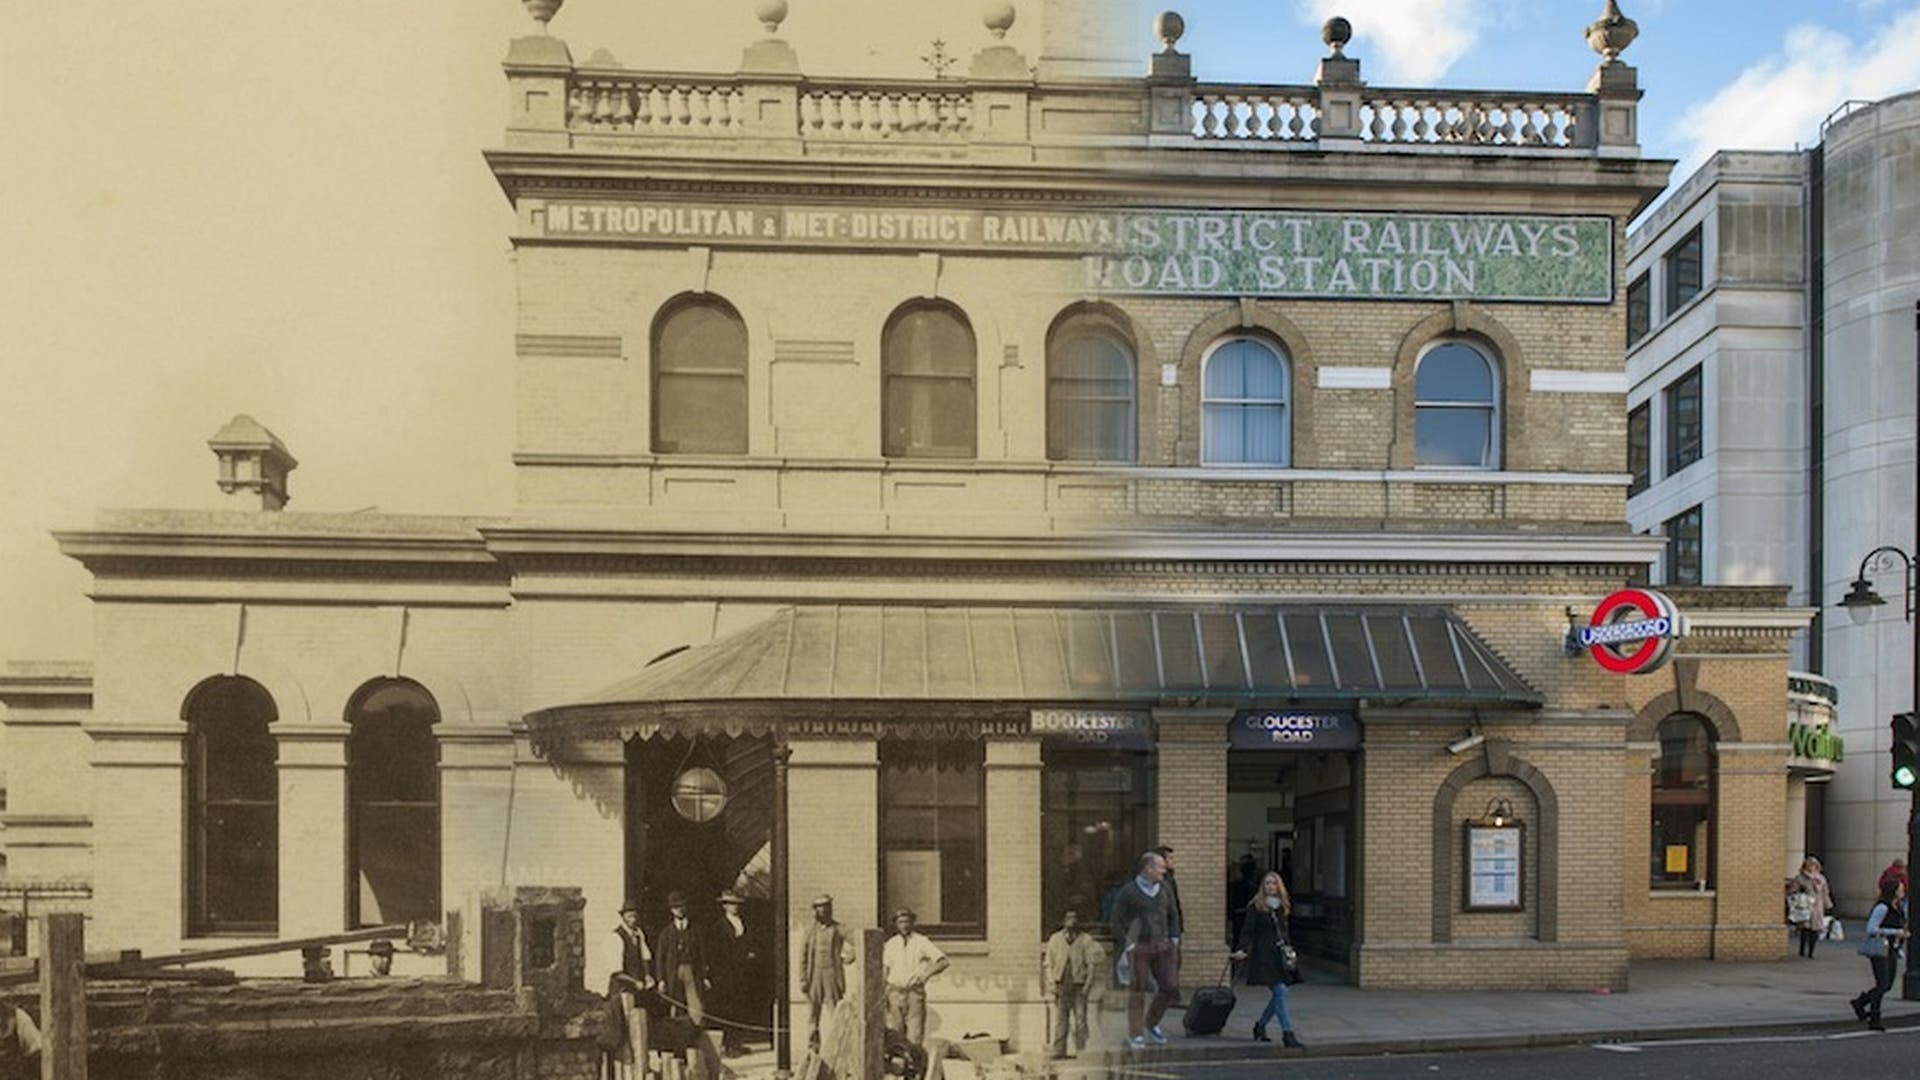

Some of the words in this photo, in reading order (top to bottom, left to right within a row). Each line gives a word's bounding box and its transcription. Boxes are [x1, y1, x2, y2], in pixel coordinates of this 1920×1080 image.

[547, 203, 754, 236] METROPOLITAN
[762, 216, 777, 237] &
[1342, 218, 1581, 257] RAILWAYS
[1258, 255, 1477, 293] STATION
[1246, 715, 1339, 729] GLOUCESTER
[1272, 730, 1314, 743] ROAD
